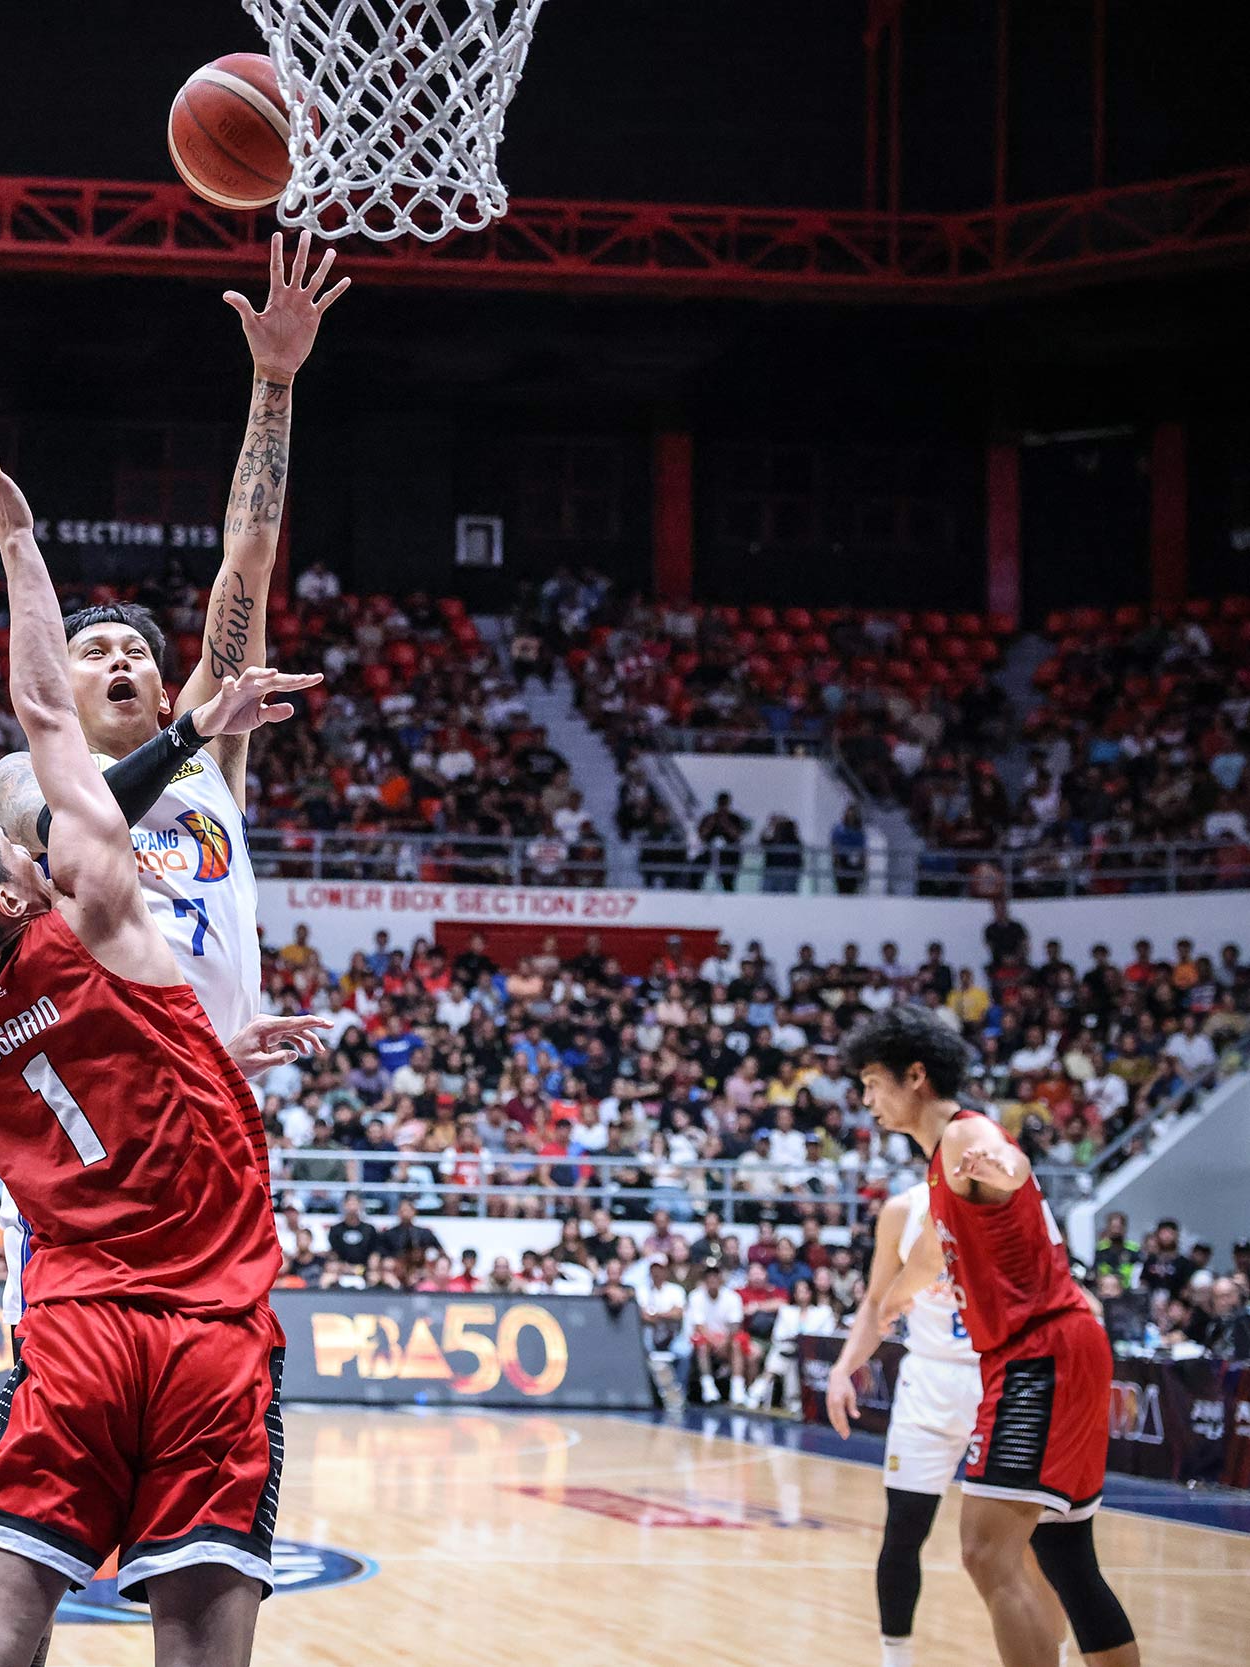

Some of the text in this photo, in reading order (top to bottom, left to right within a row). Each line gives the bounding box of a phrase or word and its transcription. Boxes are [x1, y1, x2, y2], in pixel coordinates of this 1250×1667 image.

[57, 519, 164, 546] SECTION
[208, 571, 254, 680] Jesus
[131, 828, 179, 851] OPANG
[135, 850, 188, 880] iga
[287, 885, 638, 918] LOWER BOX SECTION 207
[173, 898, 209, 956] 7
[21, 1051, 108, 1167] 1
